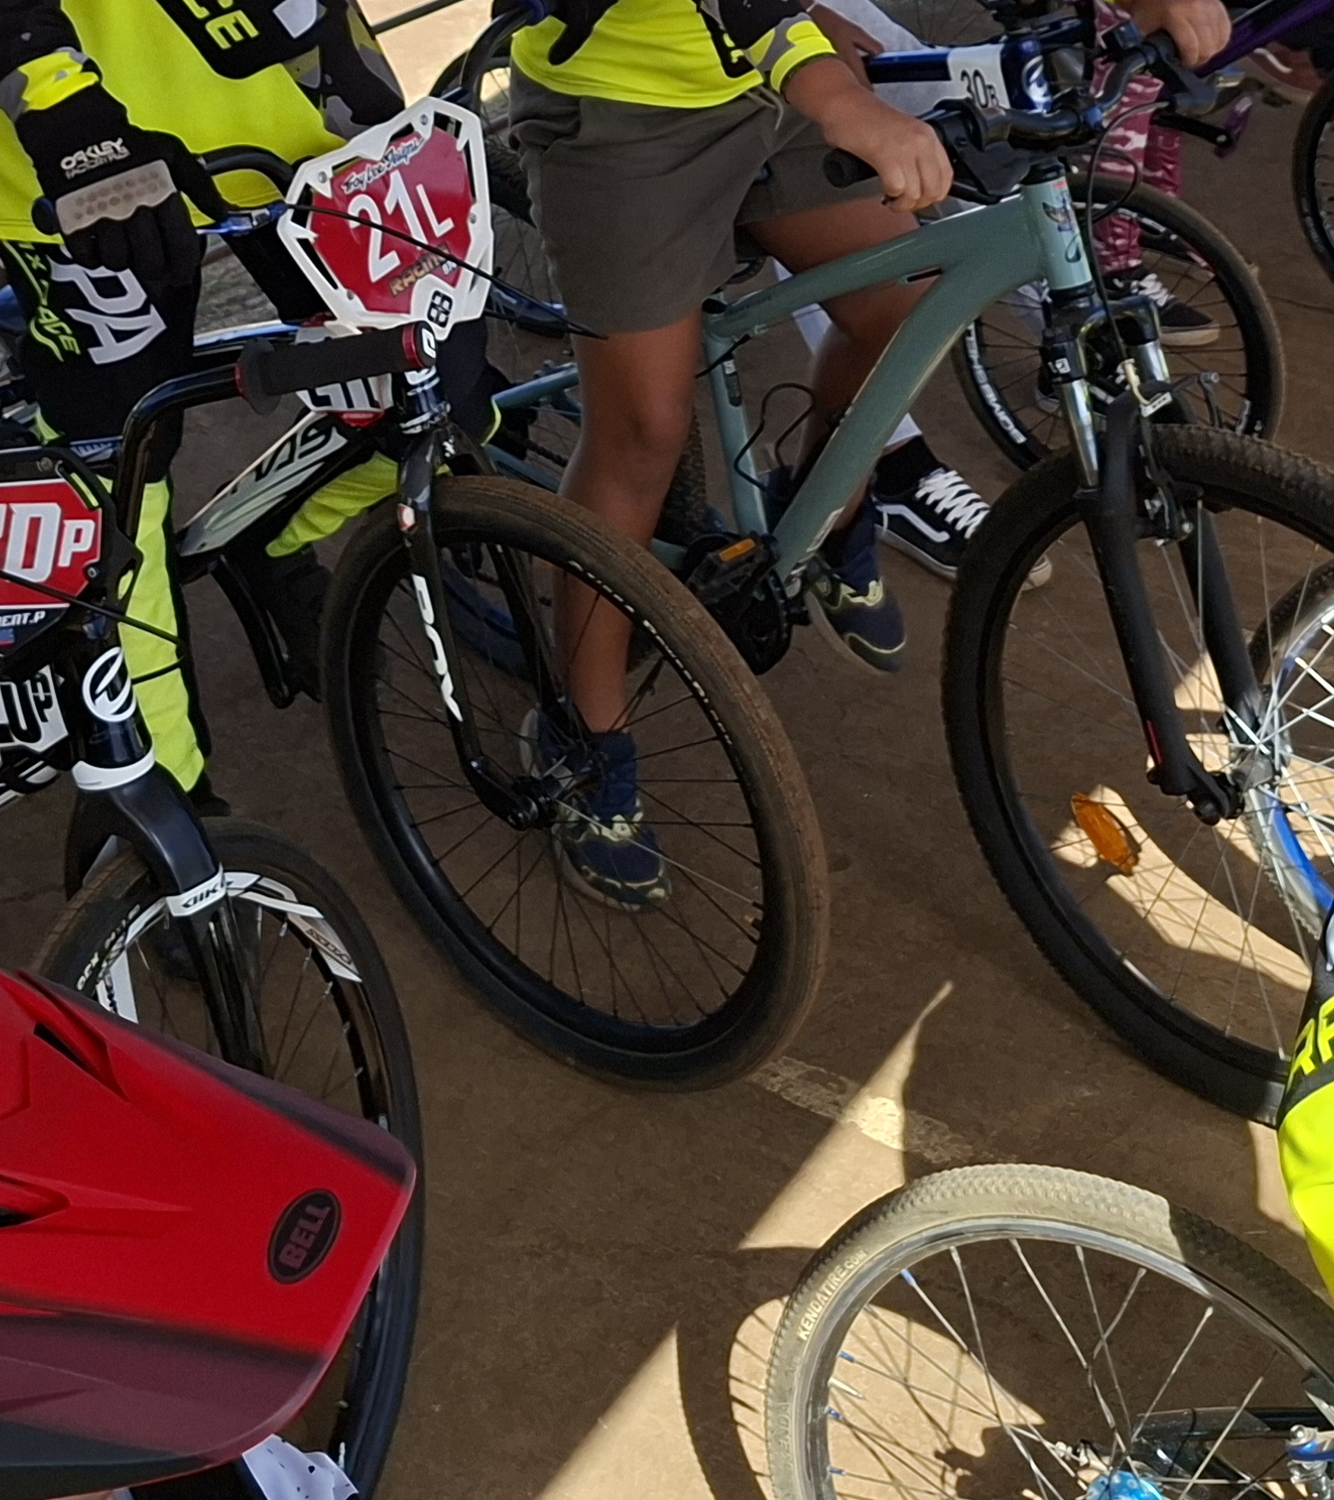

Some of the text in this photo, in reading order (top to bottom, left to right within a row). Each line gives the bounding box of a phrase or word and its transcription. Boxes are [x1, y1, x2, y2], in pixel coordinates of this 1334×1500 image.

[60, 137, 123, 170] OAKLEY
[342, 172, 366, 194] Troy
[365, 160, 388, 187] Lee
[348, 169, 455, 284] 21L
[278, 1203, 332, 1270] BELL
[796, 1249, 867, 1341] KENDATIRE.COM
